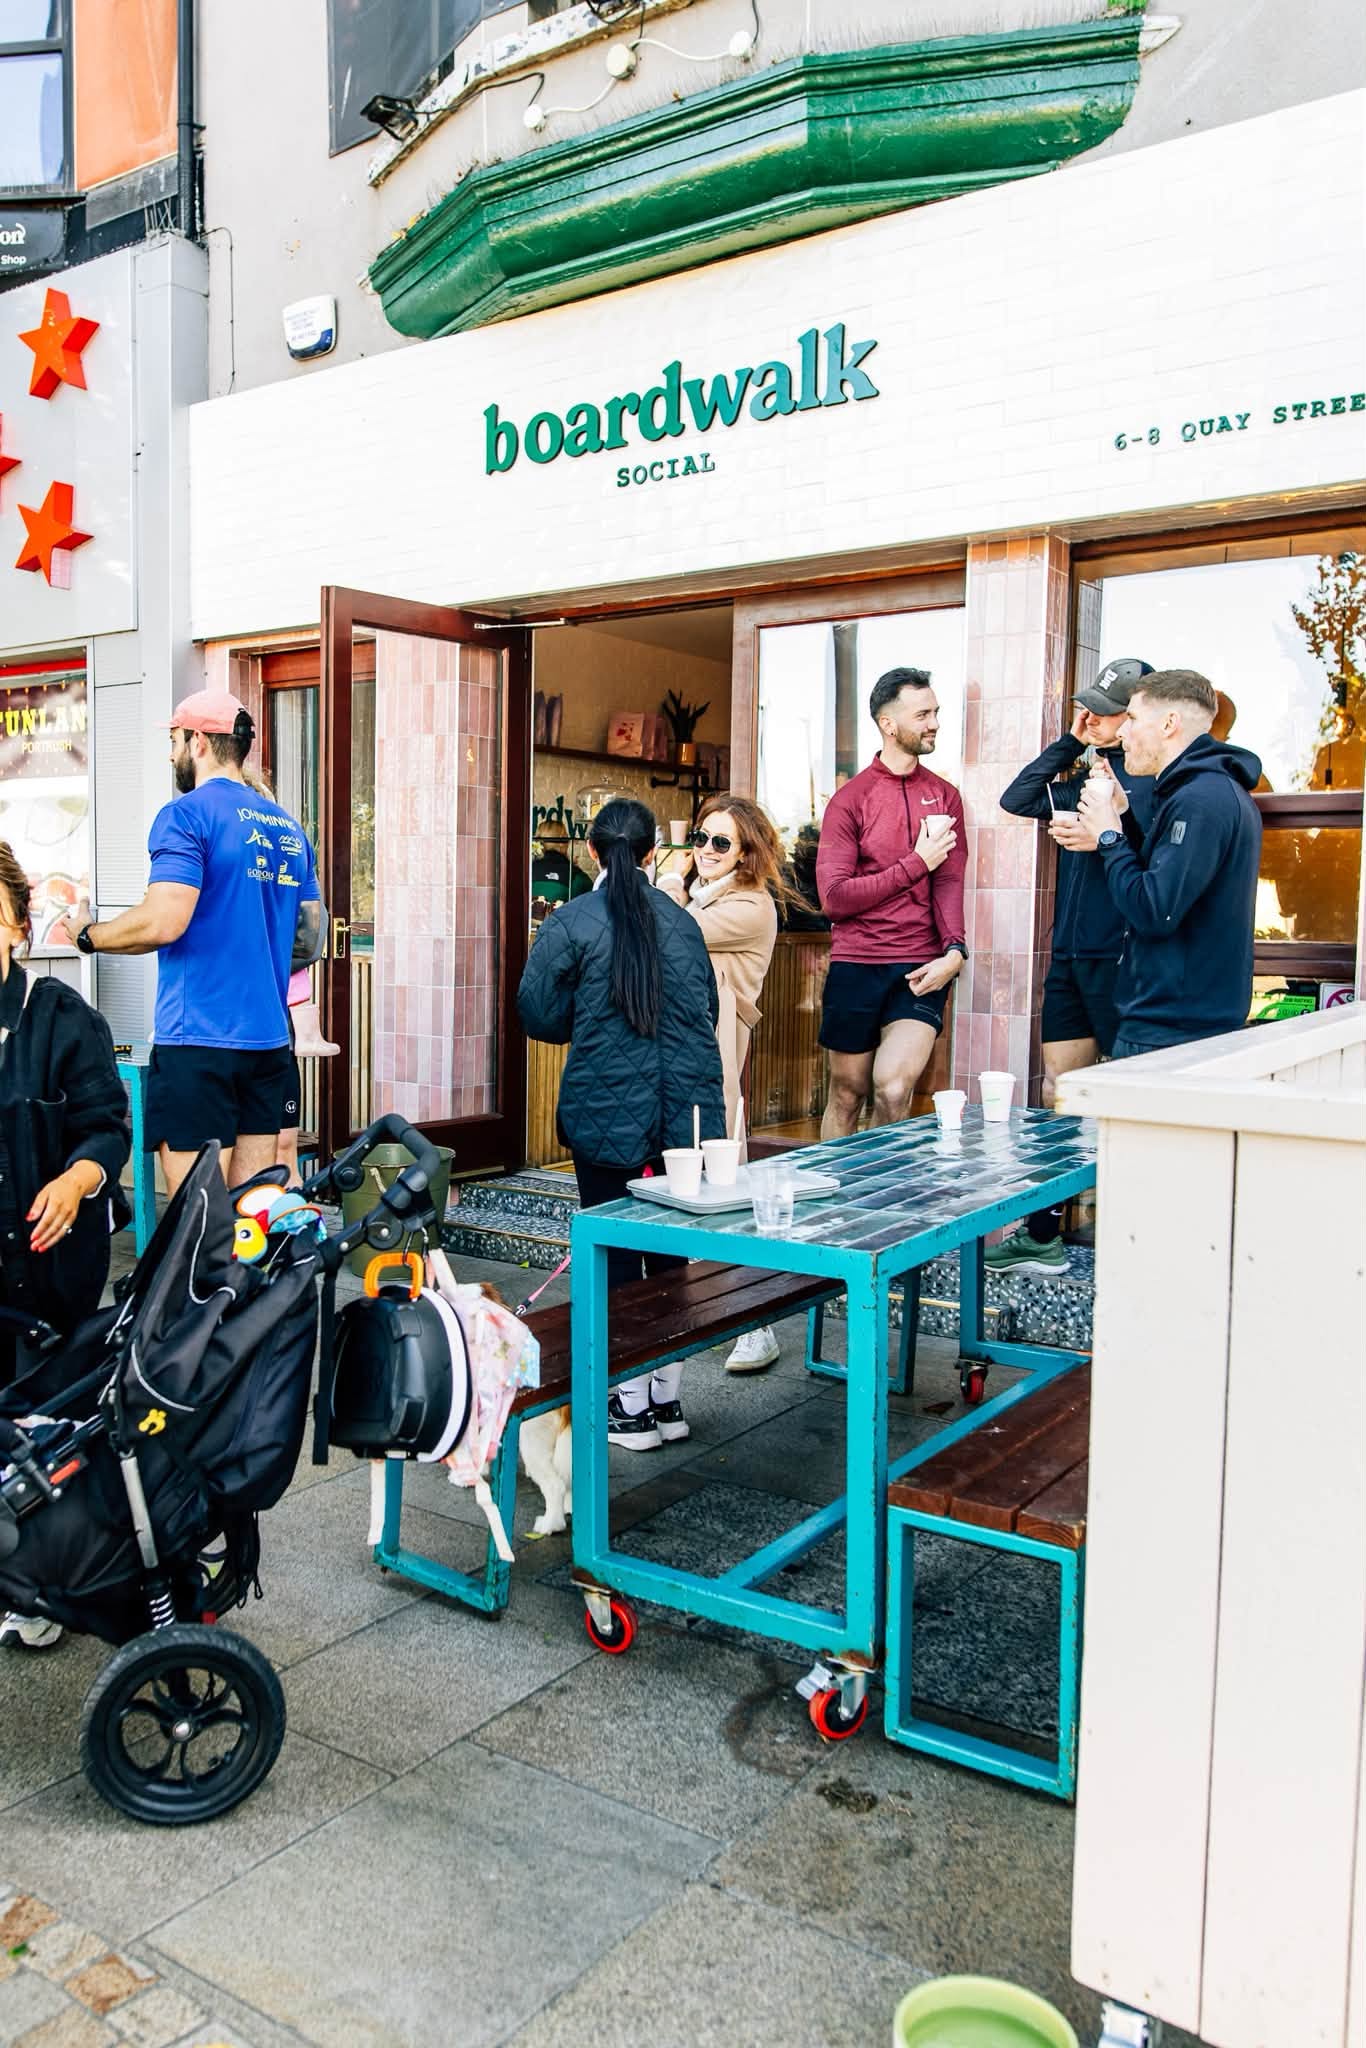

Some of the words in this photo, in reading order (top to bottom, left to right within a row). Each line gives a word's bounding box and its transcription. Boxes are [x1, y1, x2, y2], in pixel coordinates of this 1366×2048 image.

[0, 222, 26, 245] on
[1, 254, 27, 266] Shop
[483, 322, 880, 475] boardwalk
[1114, 426, 1161, 451] 6-8
[1180, 412, 1251, 442] QUAY
[616, 452, 715, 488] SOCIAL
[0, 704, 87, 737] UNLAN
